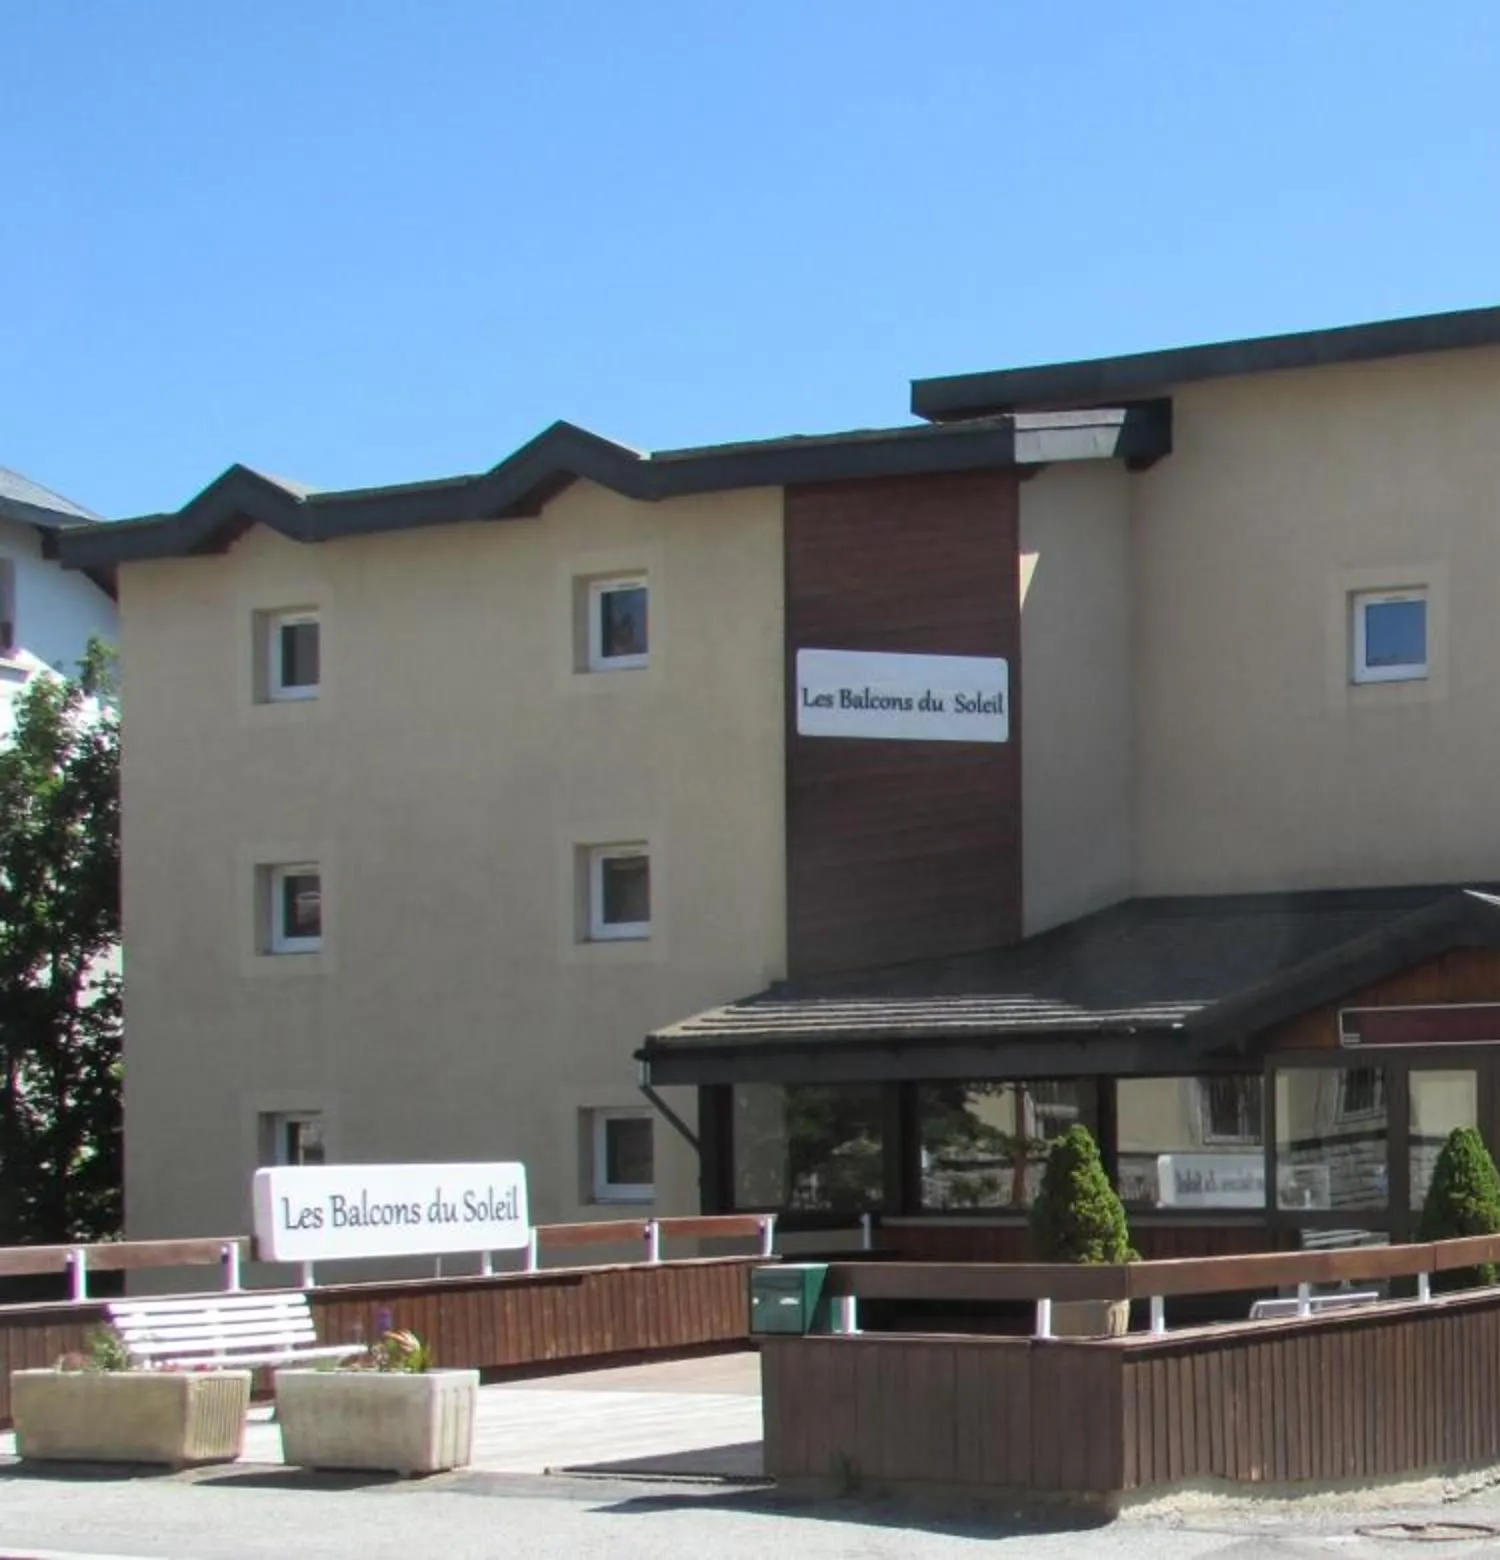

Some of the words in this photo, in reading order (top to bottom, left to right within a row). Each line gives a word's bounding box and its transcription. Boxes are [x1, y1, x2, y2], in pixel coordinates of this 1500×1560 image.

[803, 687, 833, 708] Les
[839, 687, 913, 711] Balcons
[918, 689, 943, 713] du
[954, 691, 1003, 715] Soleil
[281, 1197, 323, 1230] Les
[330, 1189, 421, 1227] Balcons
[428, 1187, 457, 1223] du
[463, 1185, 519, 1223] Soleil
